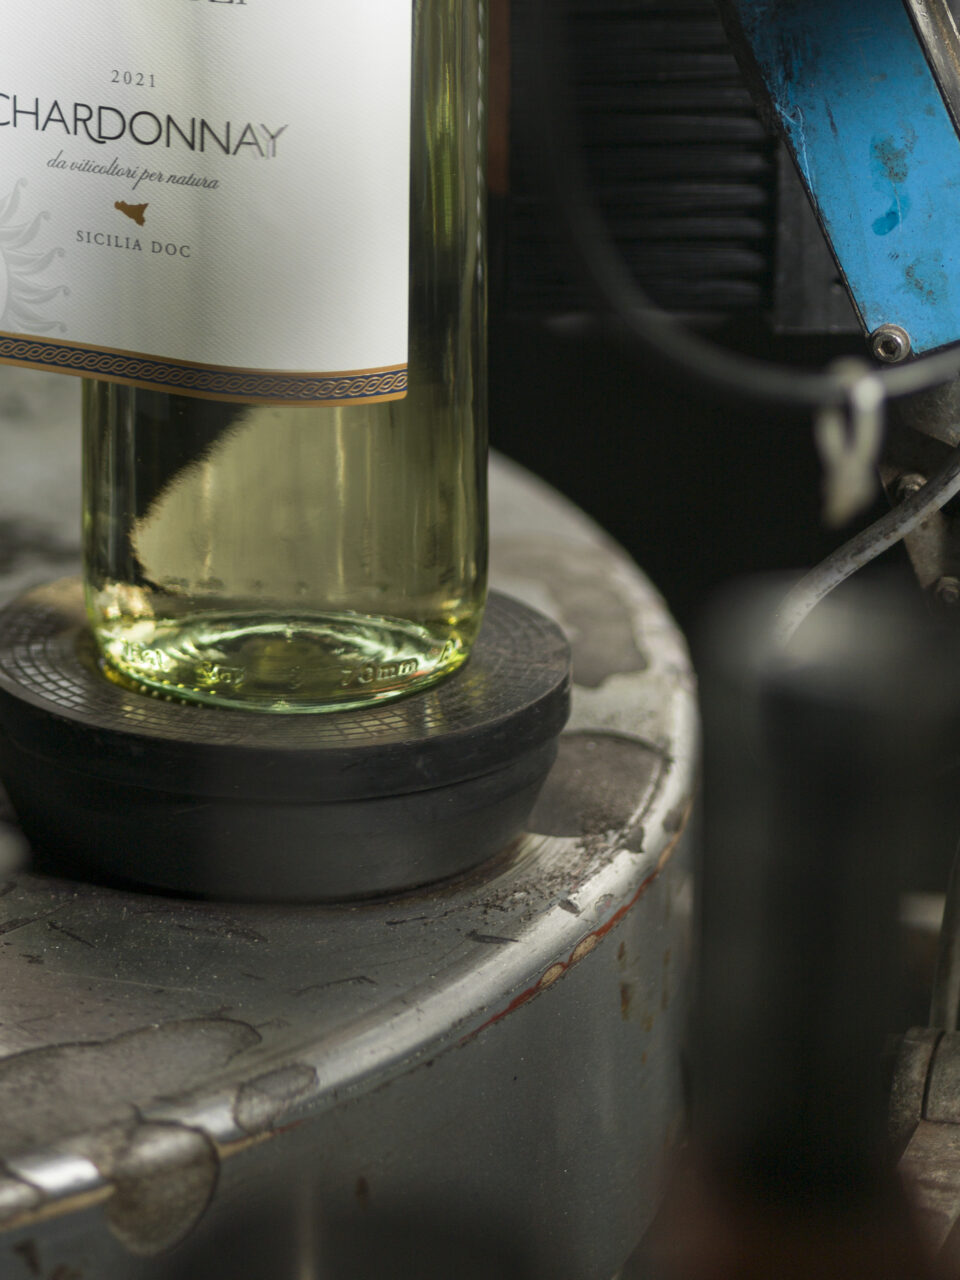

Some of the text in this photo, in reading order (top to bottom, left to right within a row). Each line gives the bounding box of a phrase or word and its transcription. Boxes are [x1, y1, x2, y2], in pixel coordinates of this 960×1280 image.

[111, 69, 156, 88] 2021
[46, 149, 220, 190] da viticoltori per natura
[76, 230, 191, 258] SICILIA DOC
